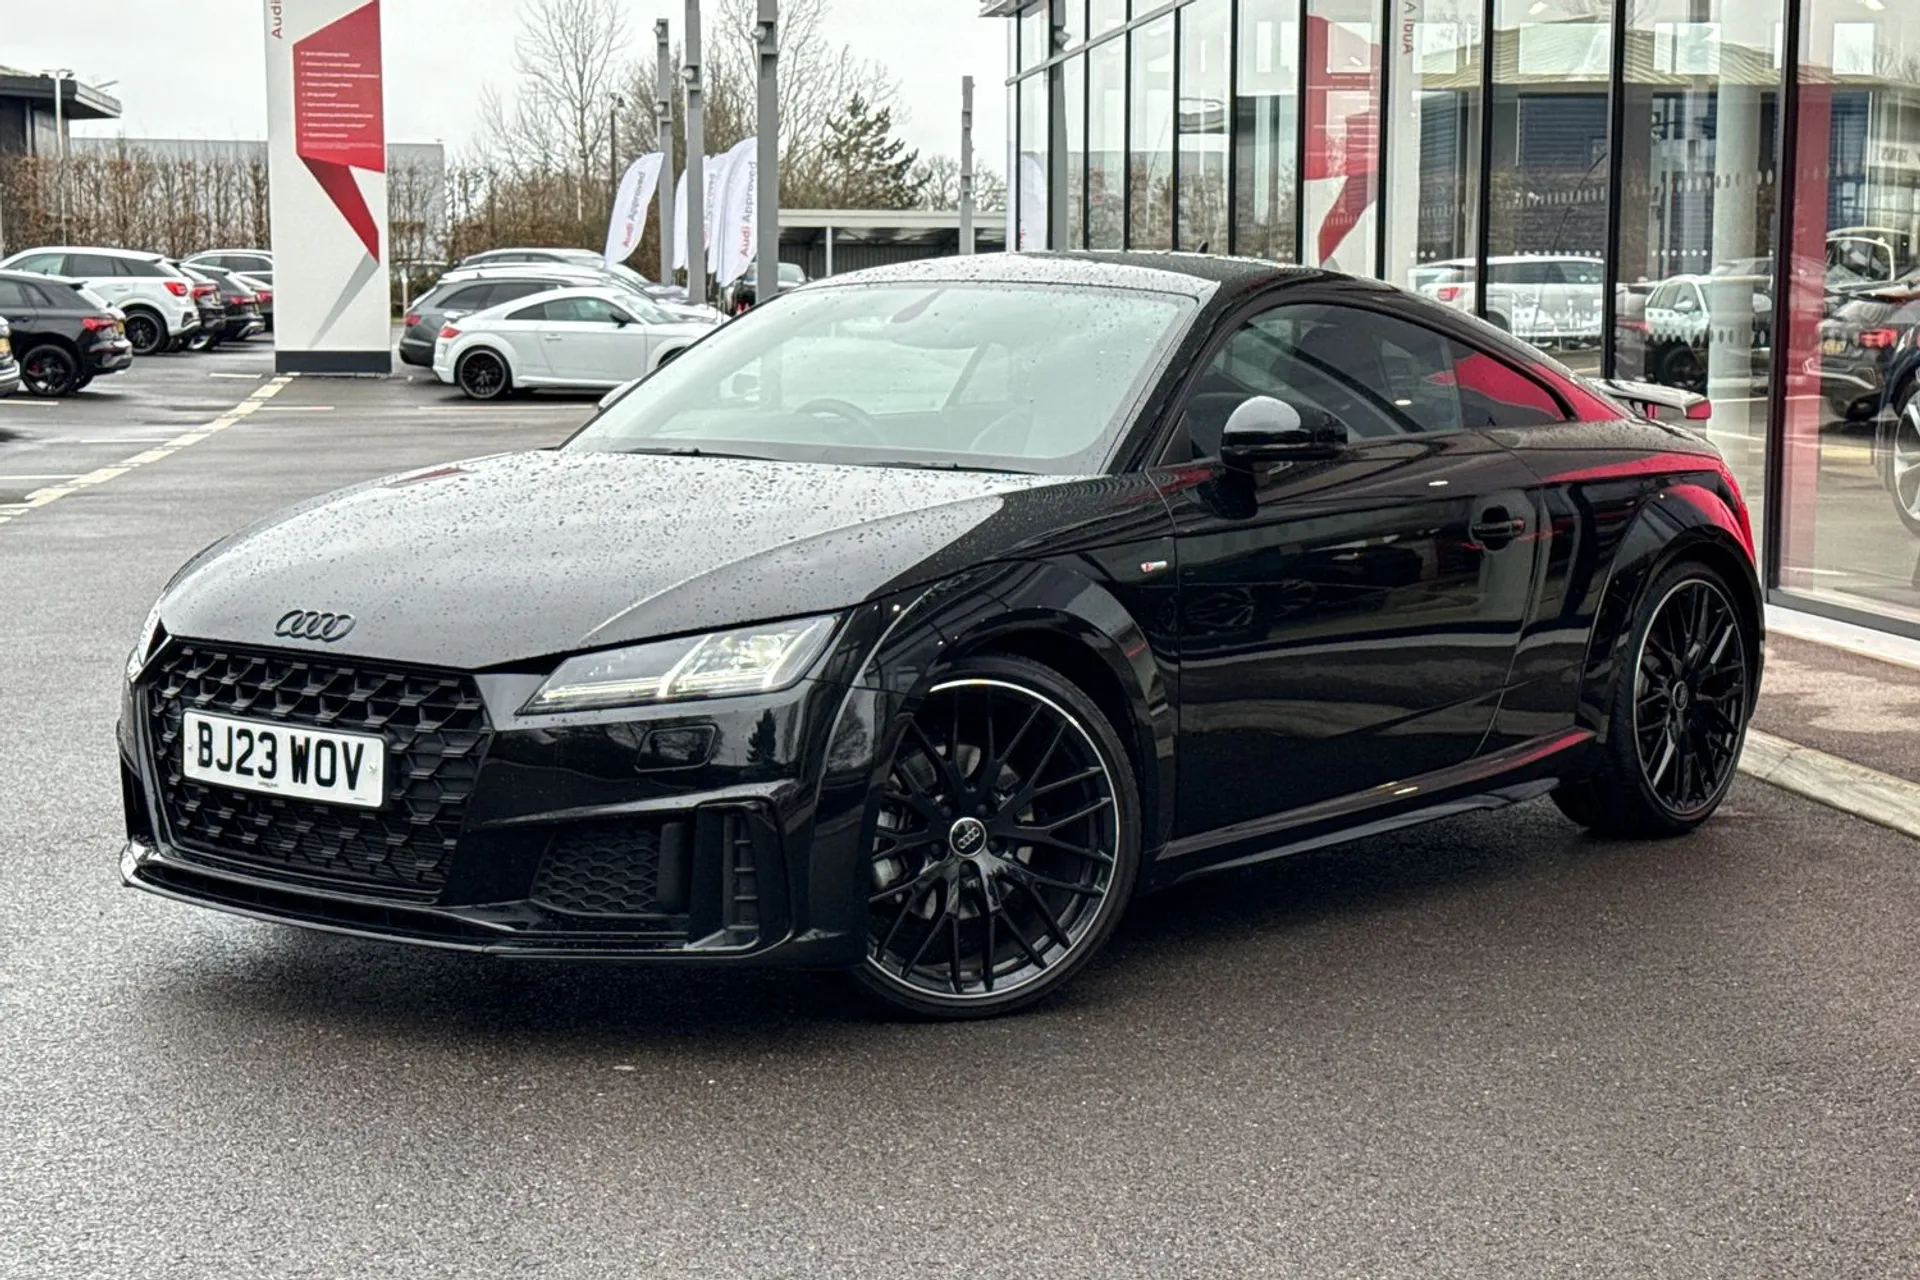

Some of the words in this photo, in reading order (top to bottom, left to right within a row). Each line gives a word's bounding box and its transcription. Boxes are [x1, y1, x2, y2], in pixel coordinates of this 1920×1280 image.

[270, 0, 283, 39] Audi
[742, 161, 758, 223] Approved
[740, 226, 751, 257] Audi
[197, 720, 278, 780] BJ23
[290, 735, 364, 791] WOV
